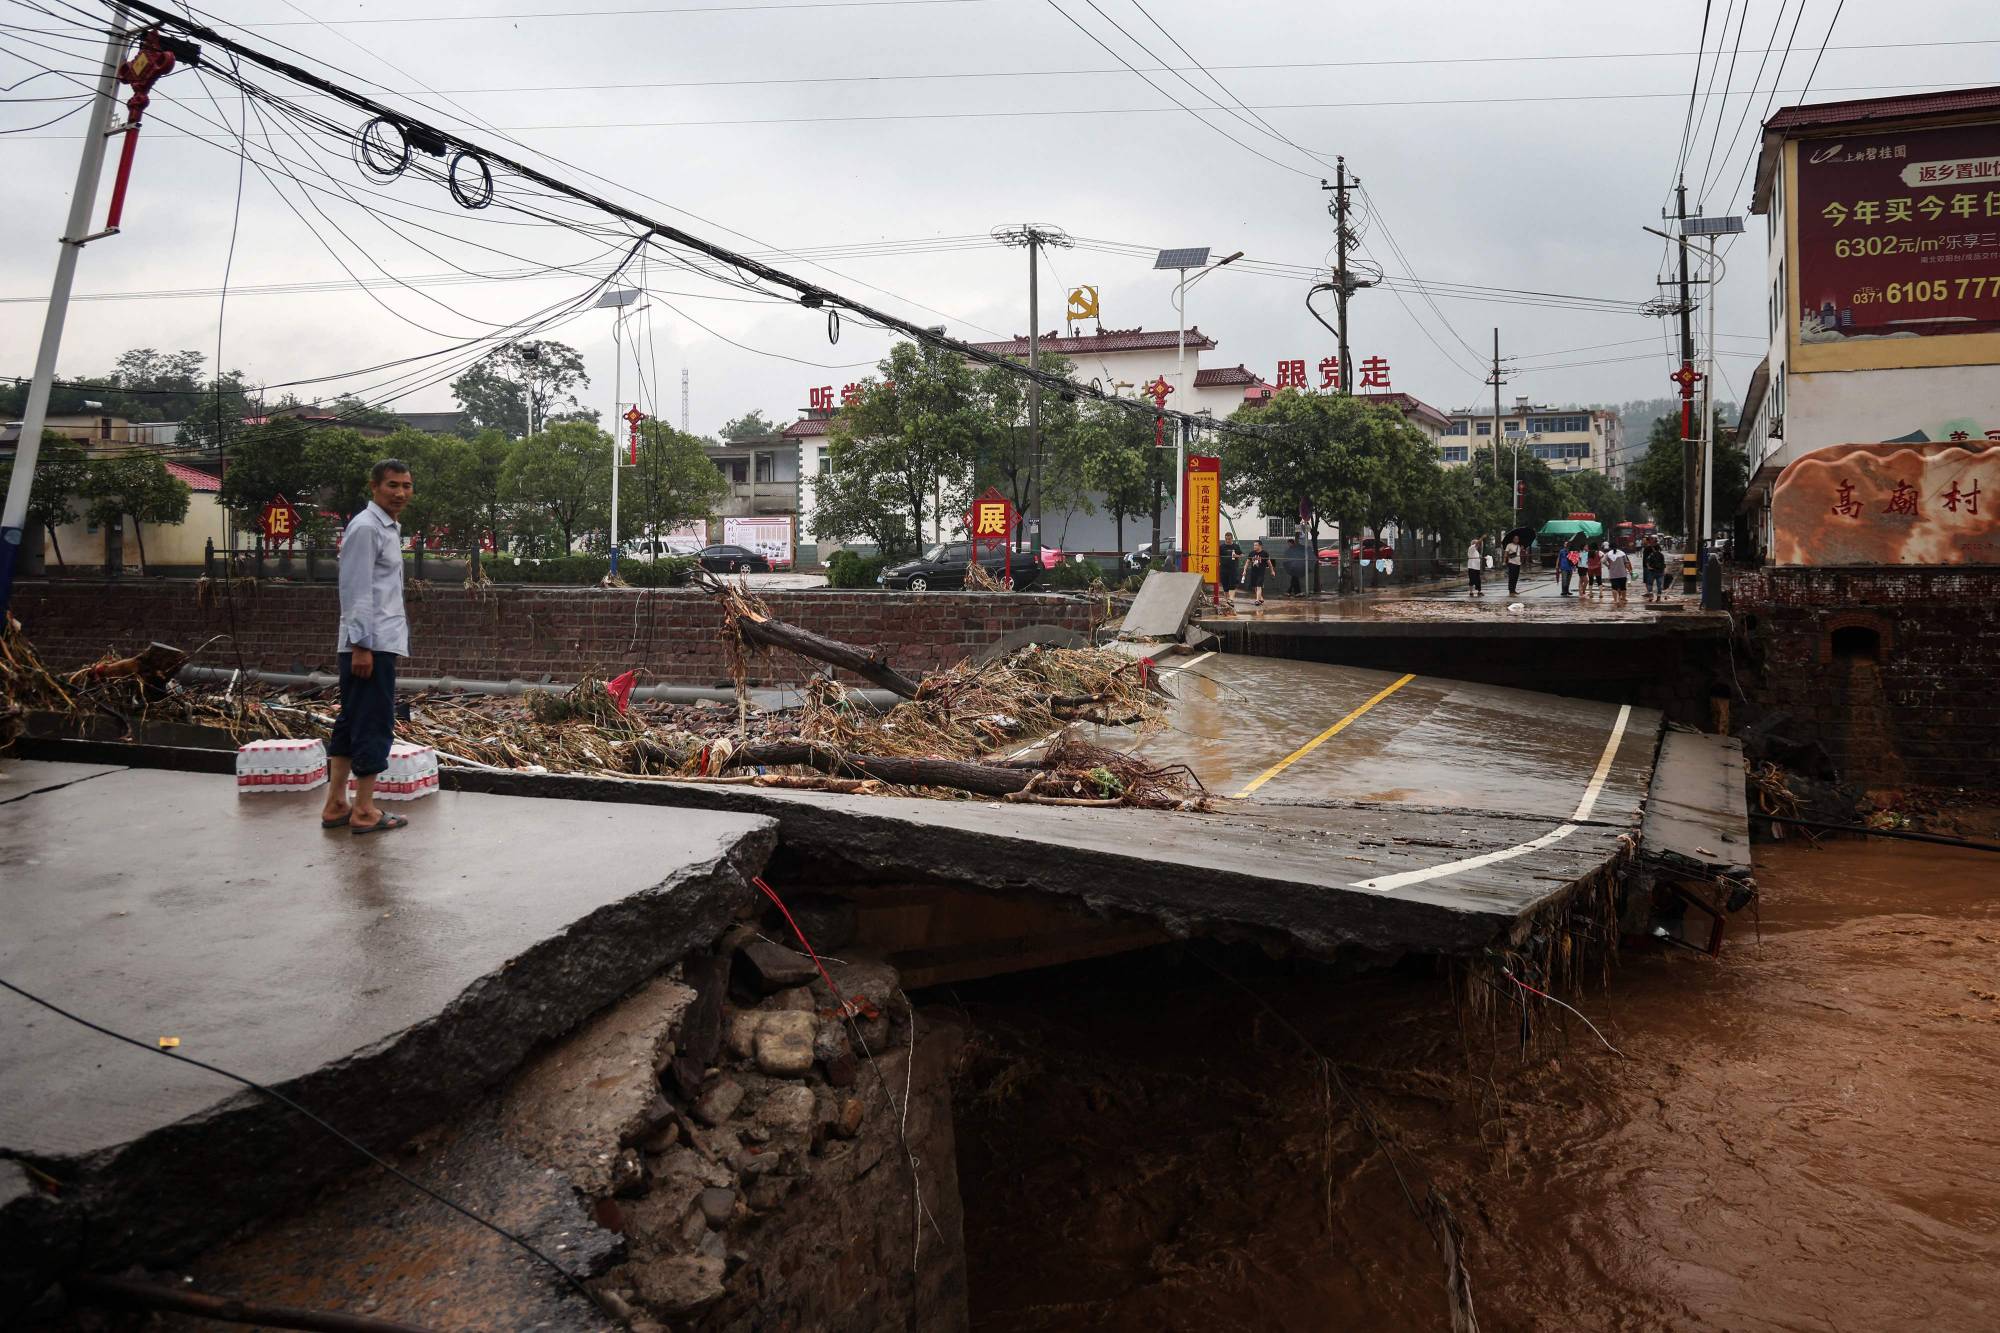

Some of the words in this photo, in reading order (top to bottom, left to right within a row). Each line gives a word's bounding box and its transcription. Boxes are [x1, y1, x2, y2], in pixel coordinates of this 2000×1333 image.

[1852, 292, 1883, 304] 0371
[1886, 279, 1948, 304] 6105
[1276, 355, 1391, 390] 跟党走
[809, 380, 896, 414] 听党
[268, 508, 289, 534] 促
[977, 504, 1006, 536] 展
[1200, 485, 1210, 573] 高庙村党建文化广场
